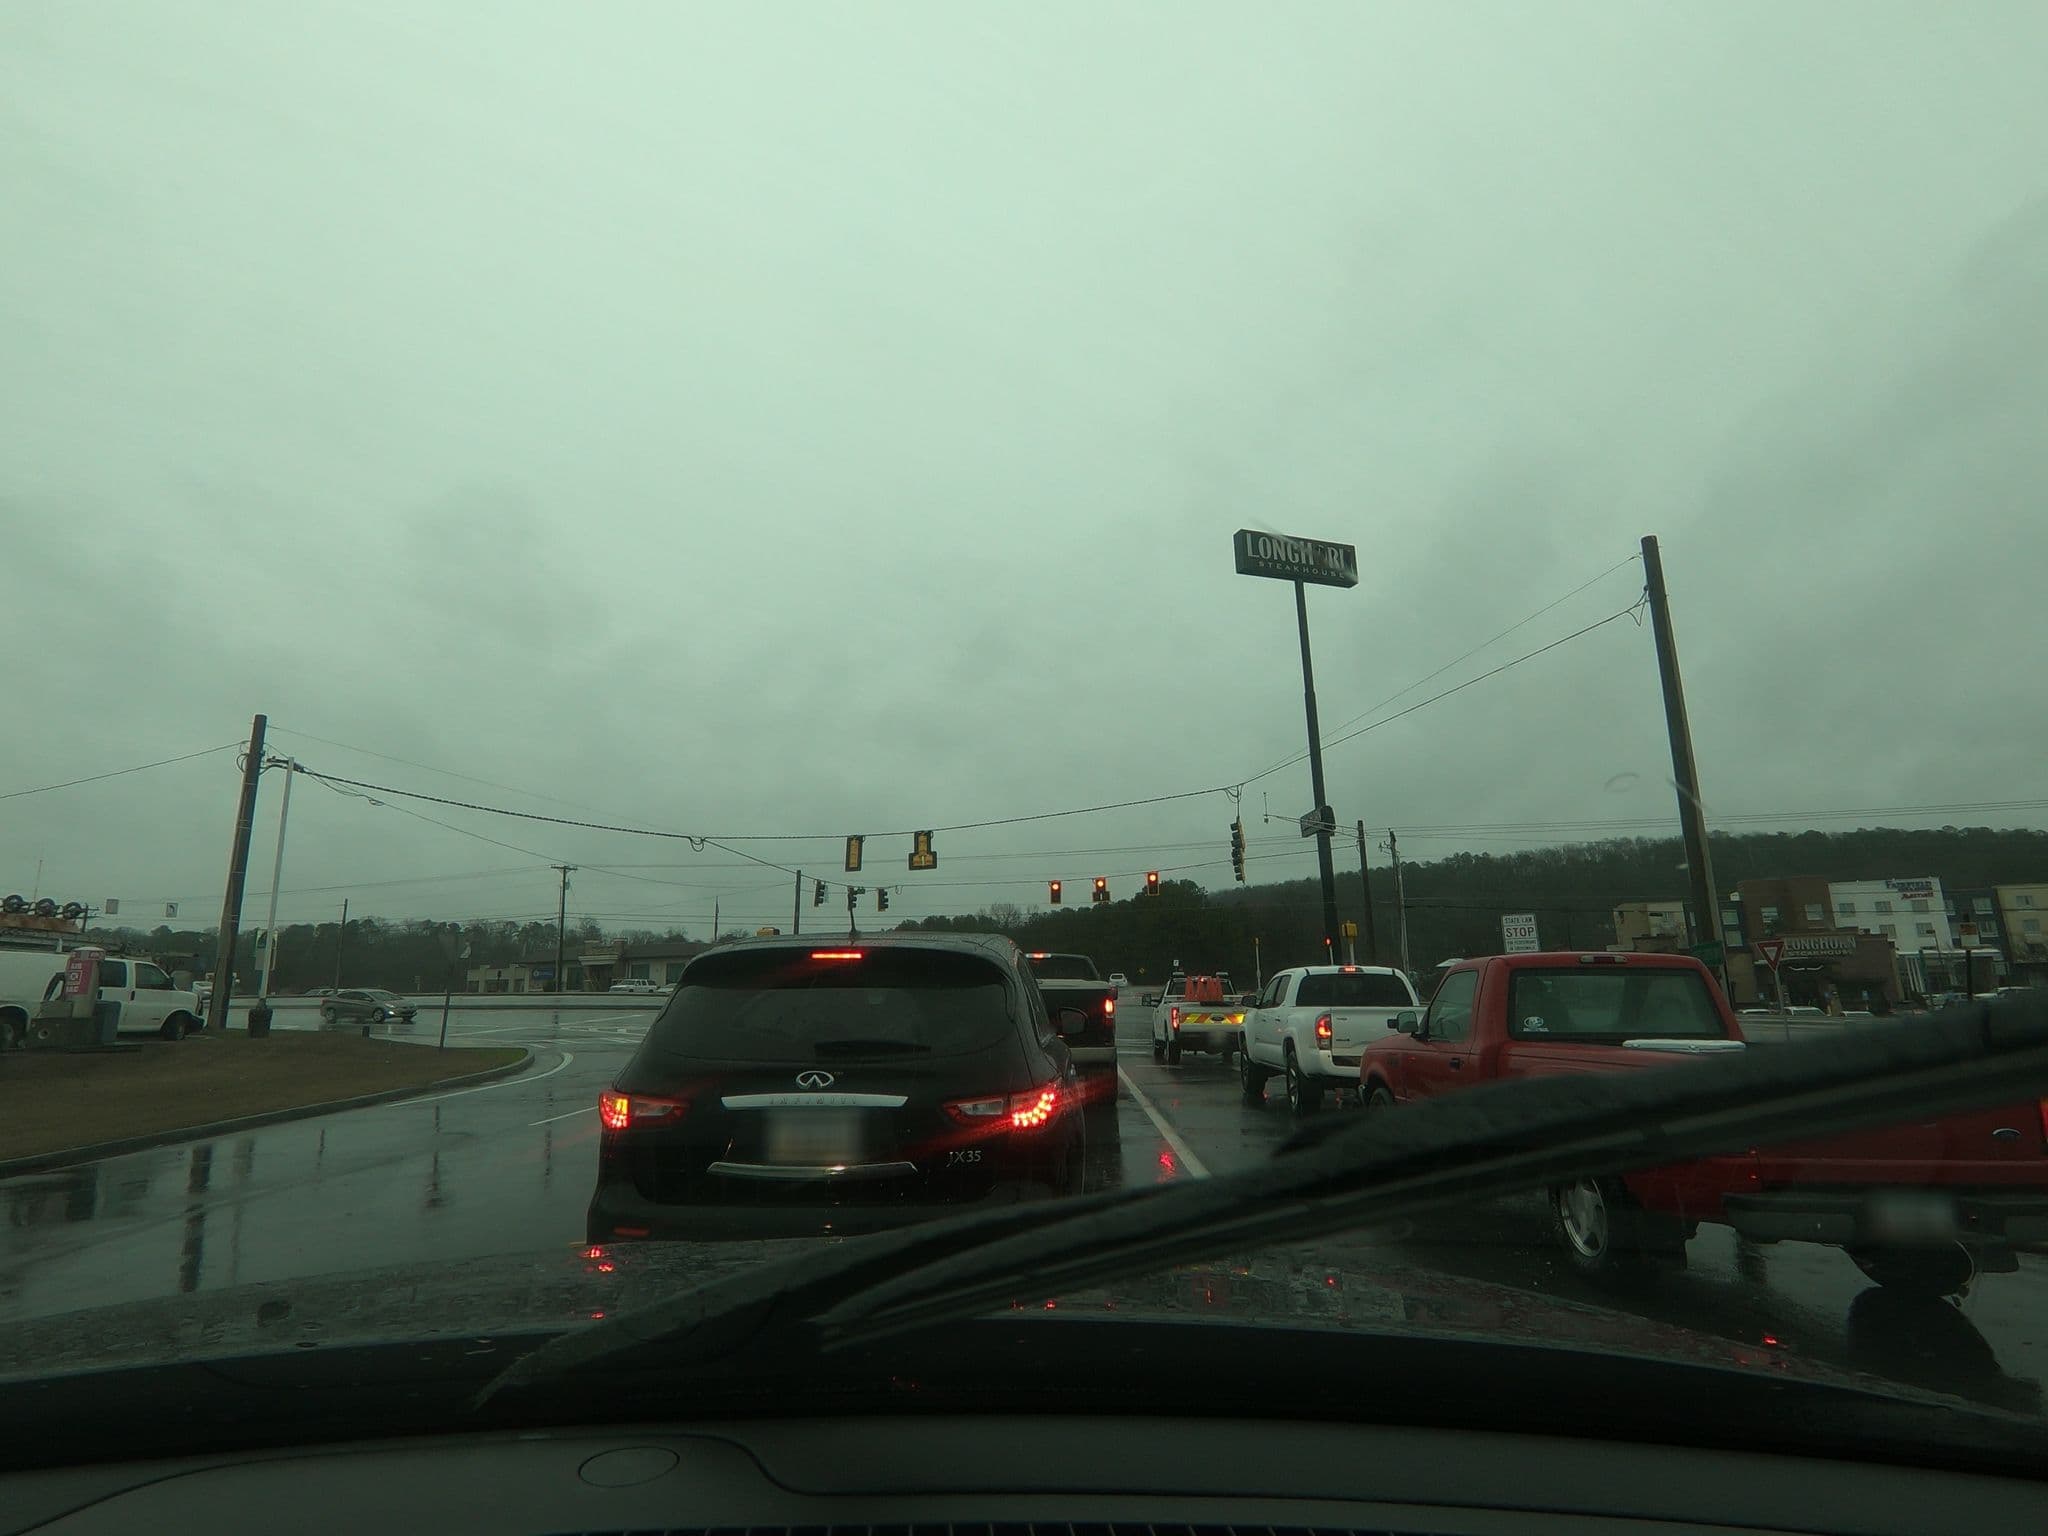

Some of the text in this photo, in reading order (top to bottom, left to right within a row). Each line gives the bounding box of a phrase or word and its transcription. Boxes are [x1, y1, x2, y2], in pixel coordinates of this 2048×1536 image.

[1246, 532, 1355, 577] LONGHR
[1258, 560, 1345, 579] STEAKHOUSE
[1505, 926, 1534, 938] STOP
